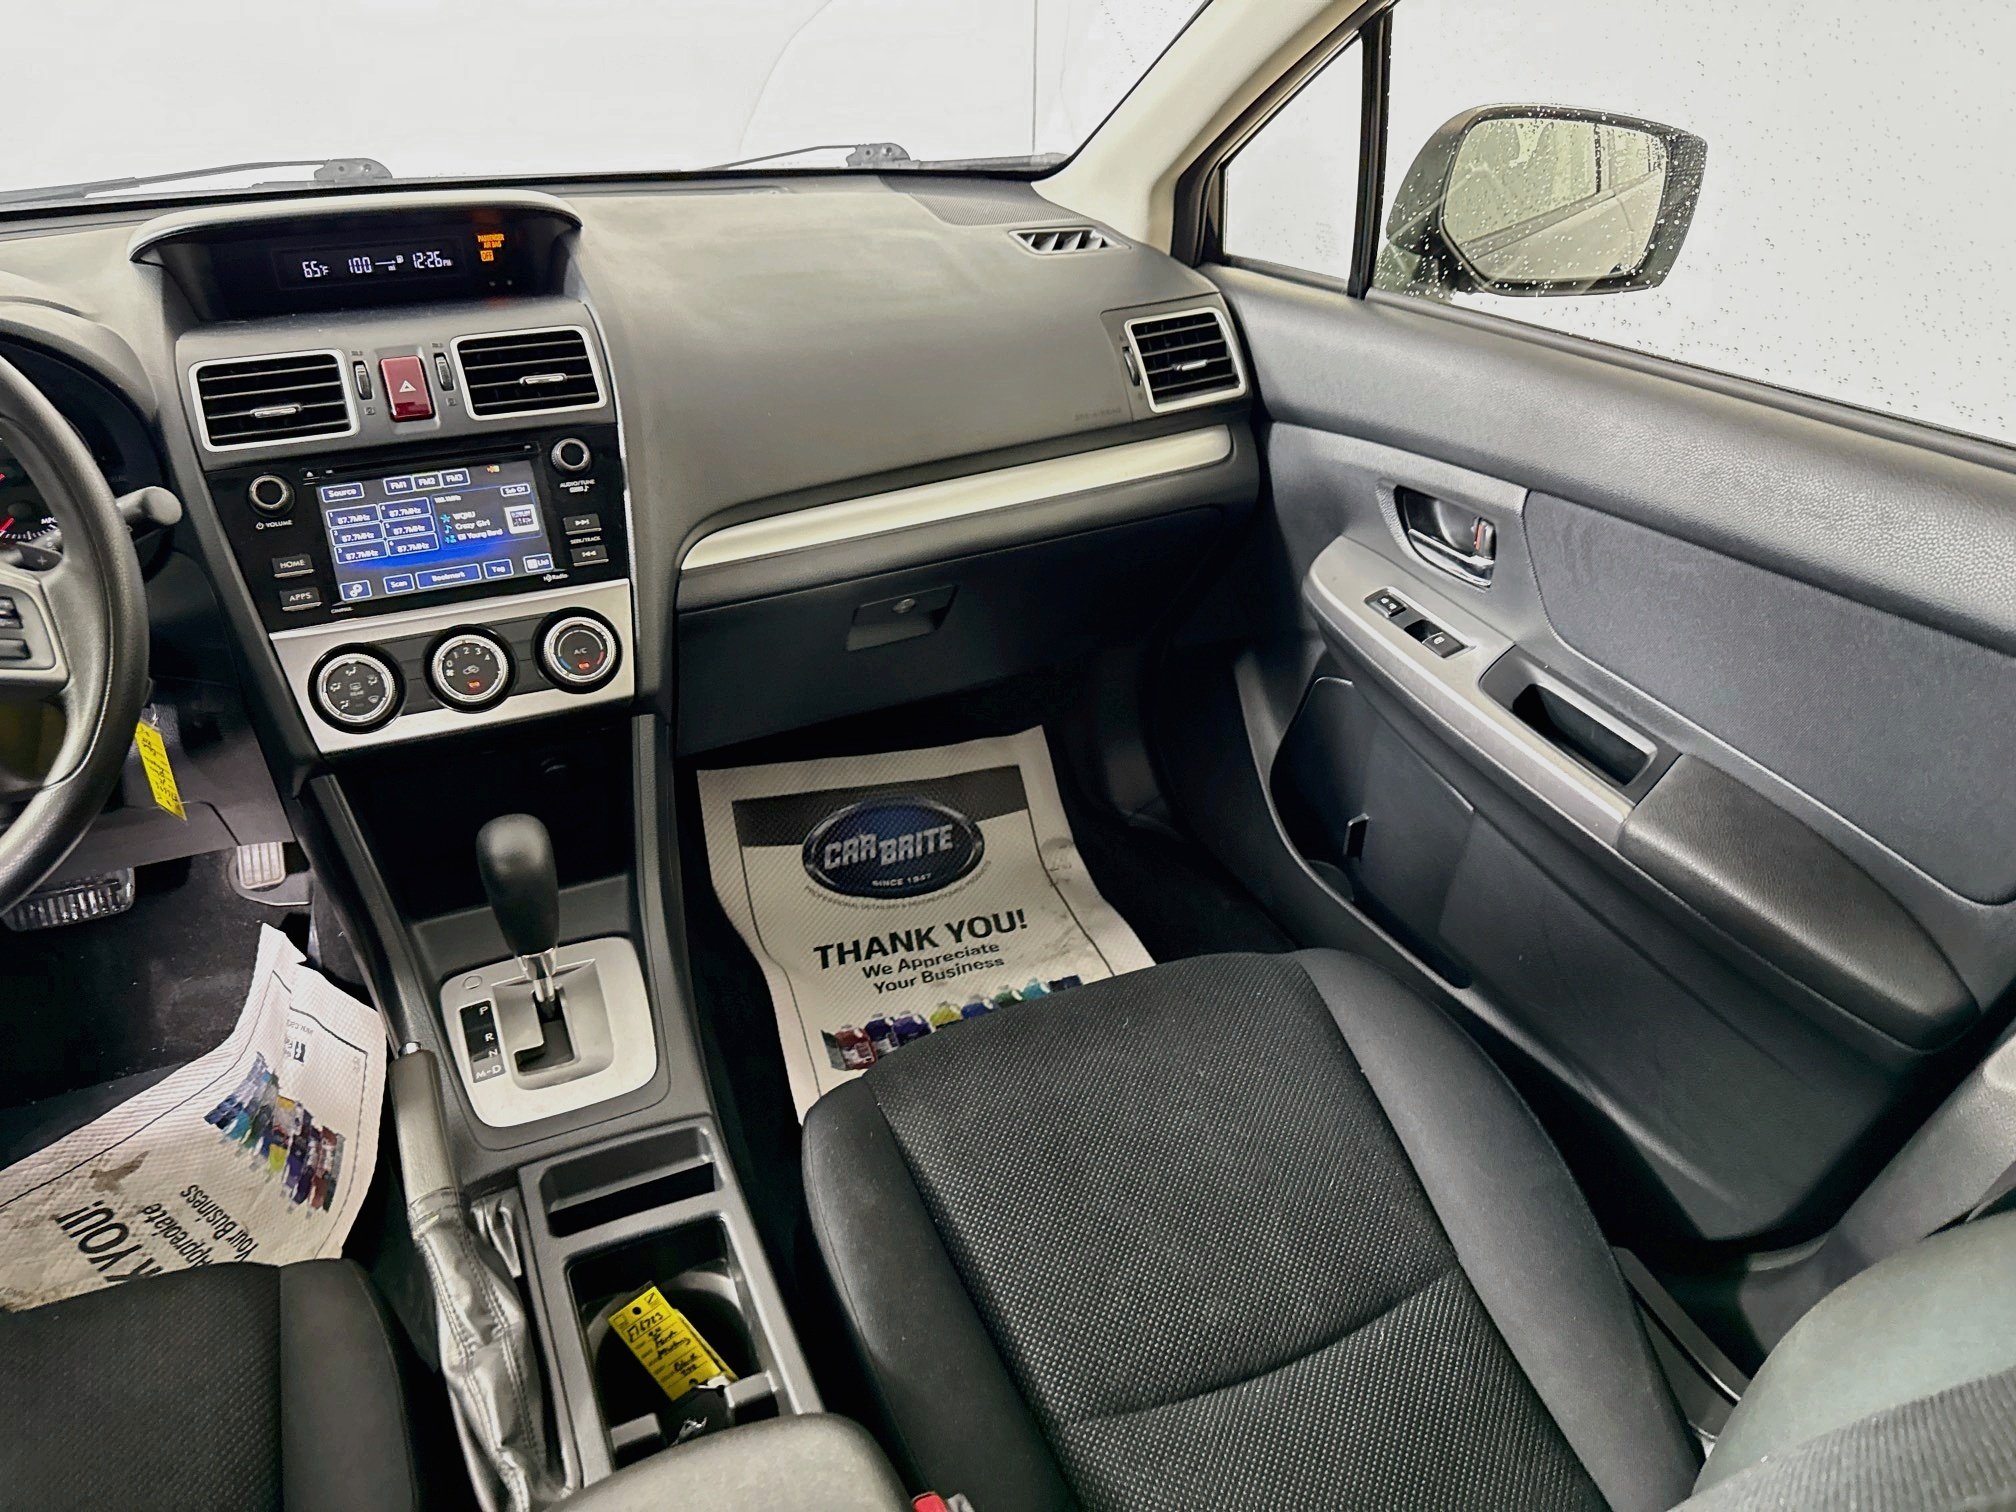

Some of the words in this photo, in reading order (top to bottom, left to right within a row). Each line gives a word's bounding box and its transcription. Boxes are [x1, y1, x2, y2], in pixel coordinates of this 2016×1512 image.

[348, 257, 372, 274] 100
[390, 481, 407, 490] FM1
[418, 478, 436, 486] FM2
[446, 474, 464, 483] FM3
[327, 487, 357, 498] Source
[265, 519, 294, 528] VOLUME
[280, 559, 306, 569] HOME
[391, 579, 408, 588] Scan
[491, 565, 506, 574] Tag
[289, 592, 313, 602] APPS
[574, 647, 588, 655] A/C
[823, 834, 877, 870] CAR
[879, 823, 954, 866] BRITE
[871, 878, 904, 887] SINCE
[813, 925, 940, 970] THANK
[944, 908, 1029, 944] YOU!
[861, 960, 893, 979] We
[897, 941, 1001, 979] Appreciate
[873, 974, 917, 995] Your
[920, 957, 1005, 985] Business
[479, 1006, 488, 1015] P
[485, 1033, 494, 1041] R
[488, 1049, 498, 1057] N
